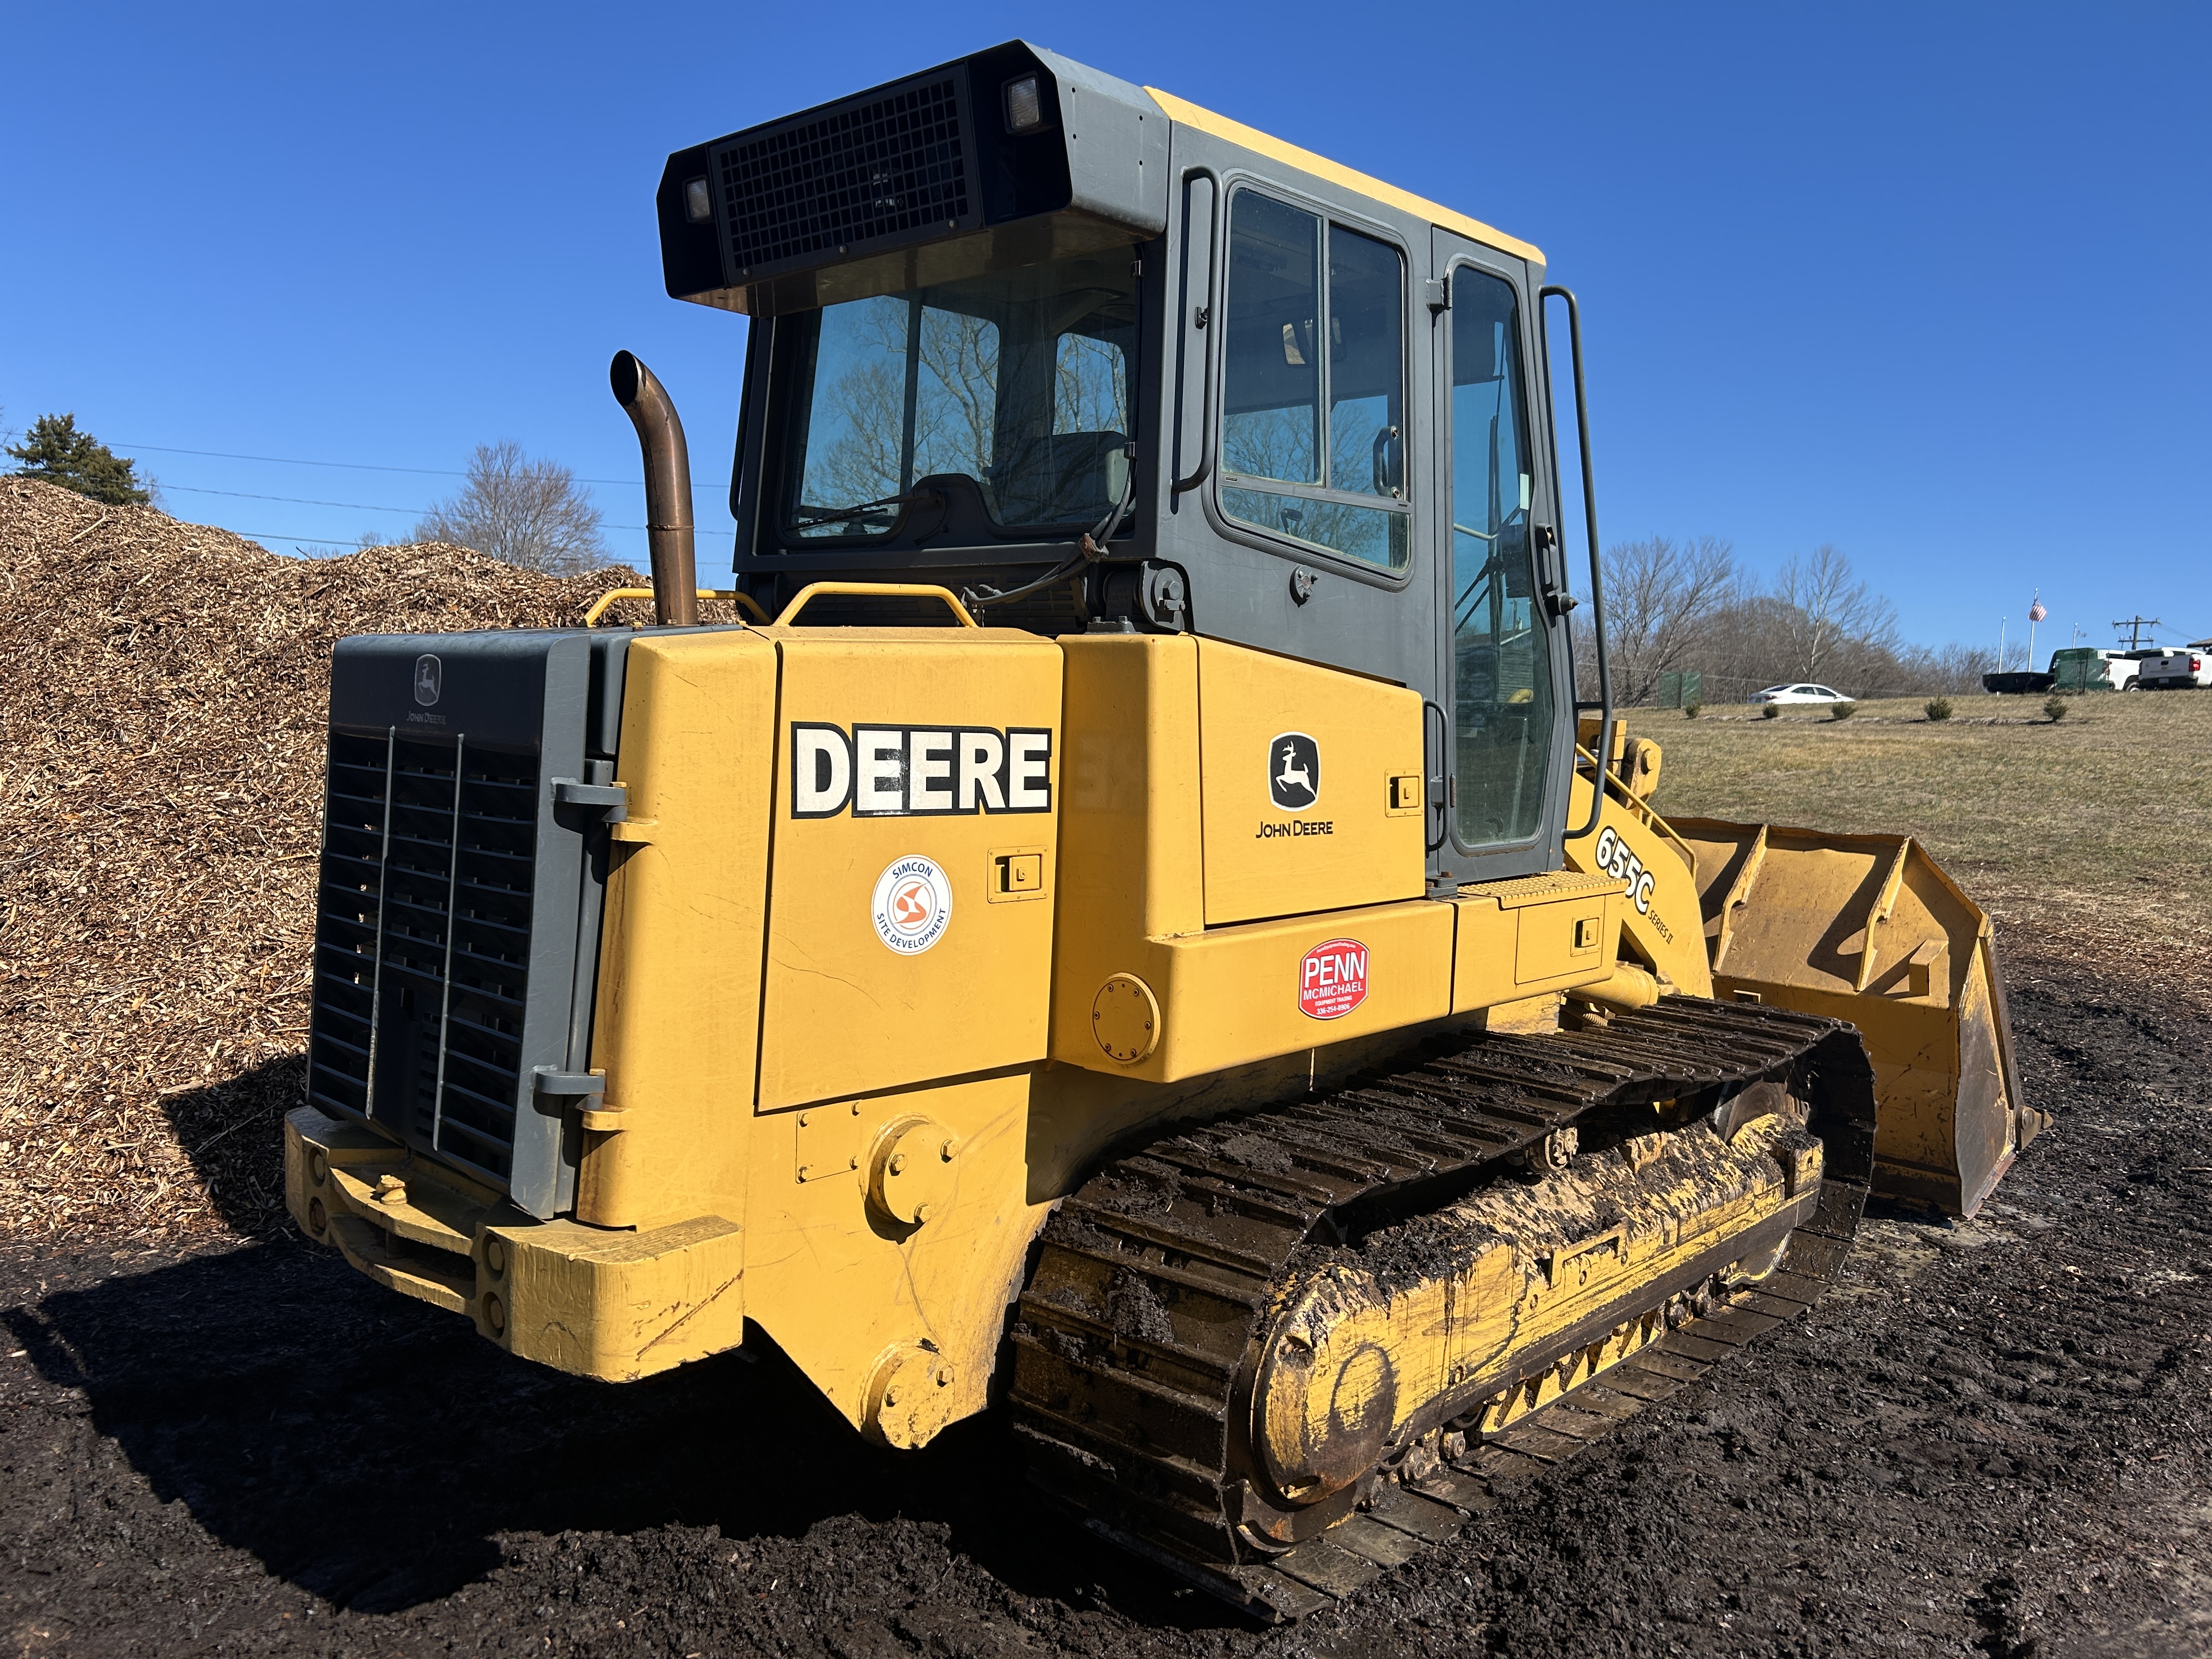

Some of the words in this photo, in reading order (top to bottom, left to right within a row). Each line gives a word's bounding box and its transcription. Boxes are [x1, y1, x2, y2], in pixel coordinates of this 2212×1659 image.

[406, 710, 424, 723] JOHN
[791, 721, 1052, 819] DEERE
[1255, 821, 1291, 839] JOHN
[1293, 820, 1333, 837] DEERE
[893, 862, 933, 879] SIMCON
[1596, 826, 1655, 915] 655C
[877, 913, 891, 936] SITE
[889, 908, 946, 949] DEVELOPMENT
[1648, 910, 1669, 938] SERIES
[1666, 931, 1674, 945] II
[1304, 950, 1365, 988] PENN
[1303, 981, 1364, 1001] MCMICHAEL
